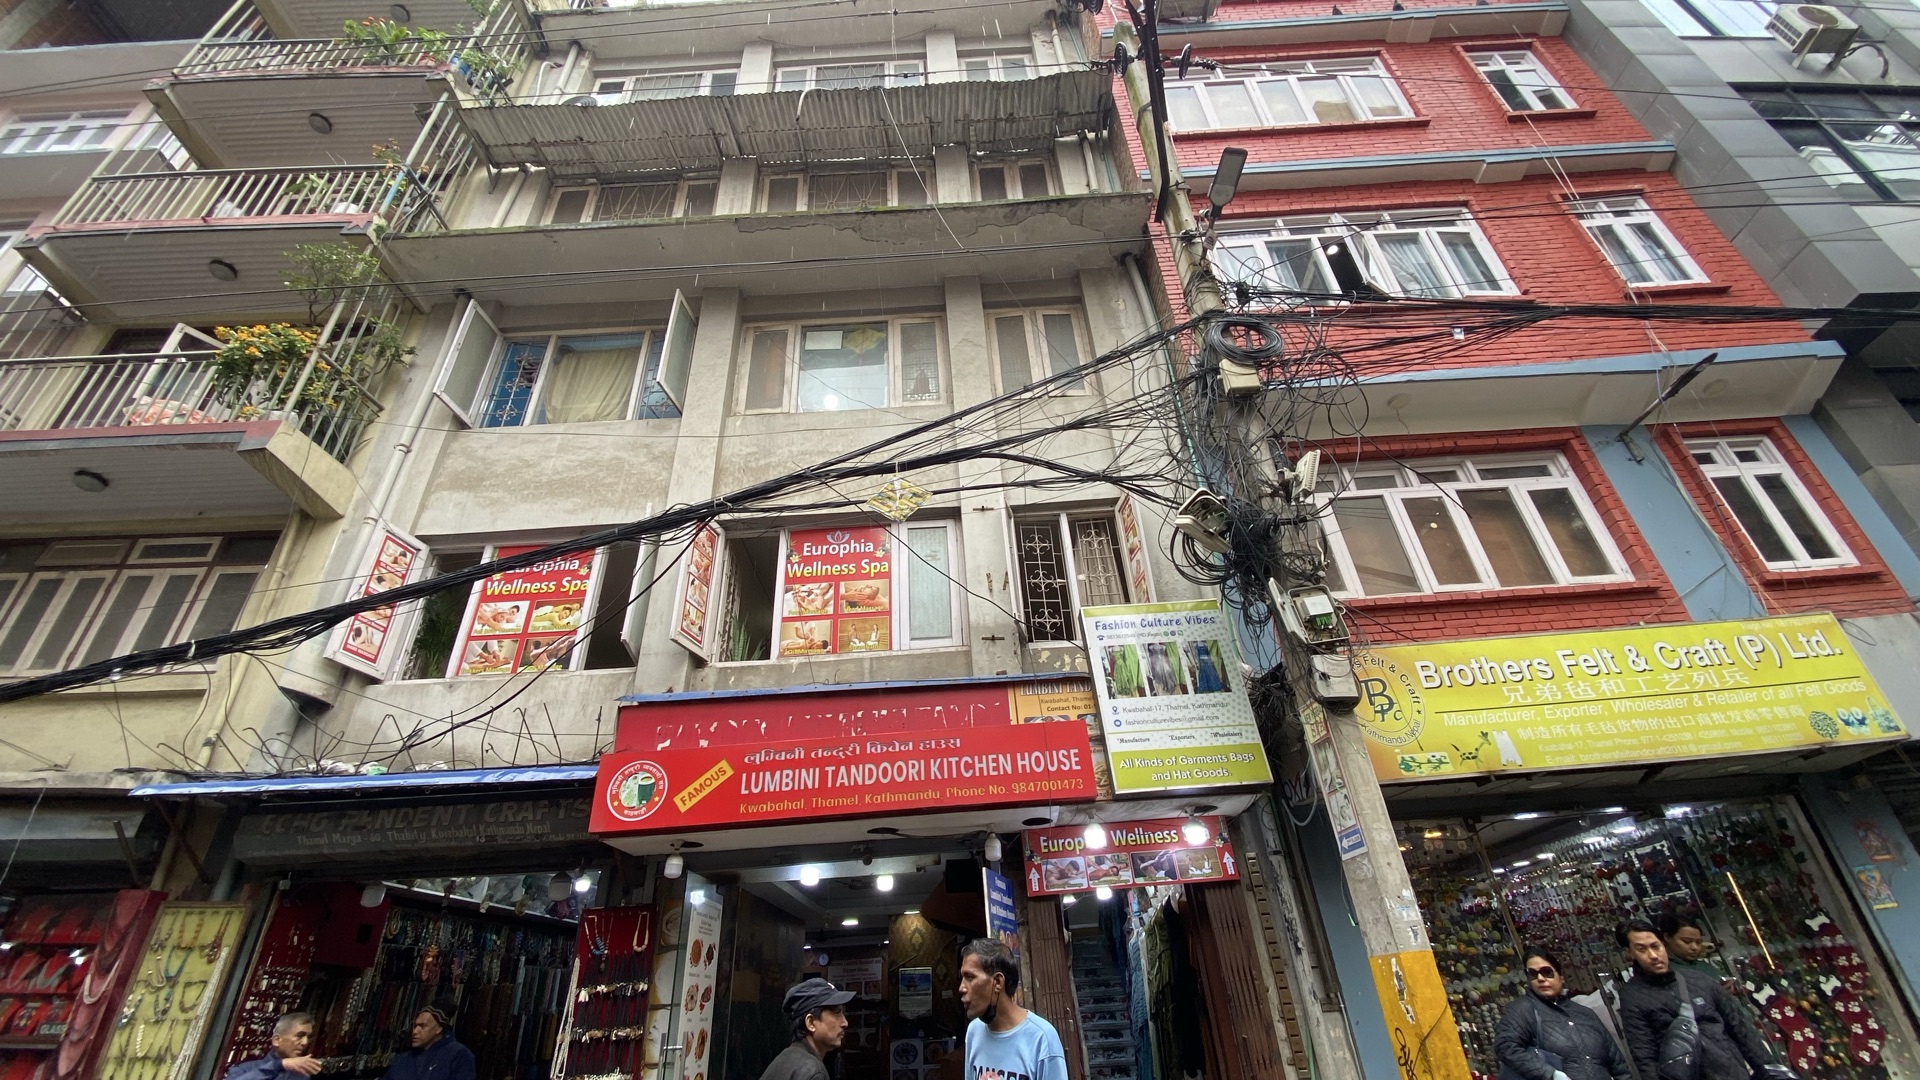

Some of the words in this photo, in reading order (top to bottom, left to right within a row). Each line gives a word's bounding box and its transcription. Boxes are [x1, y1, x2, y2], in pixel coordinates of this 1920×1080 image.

[803, 539, 874, 557] Europhia
[505, 557, 579, 575] rophia
[787, 561, 856, 578] Wellness
[861, 559, 889, 577] Spa
[486, 579, 557, 596] Wellness
[560, 577, 588, 595] Spa
[1095, 620, 1136, 631] Fashion
[1140, 617, 1181, 628] Culture
[1184, 615, 1216, 625] Vibes
[1414, 656, 1554, 689] Brothers
[1555, 648, 1622, 677] Felt
[1624, 645, 1652, 672] &
[1654, 637, 1734, 670] Craft
[1734, 633, 1782, 669] (P)
[1779, 629, 1842, 660] Ltd.
[1021, 681, 1062, 696] LUMBINI
[1362, 654, 1384, 667] Felt
[1389, 664, 1396, 673] &
[1400, 674, 1420, 704] Craft
[1444, 709, 1541, 727] Manufacturer,
[1544, 704, 1608, 720] Exporter,
[1611, 693, 1688, 714] Wholesaler
[1693, 693, 1704, 706] &
[1706, 687, 1758, 706] Retailer
[1762, 686, 1775, 701] of
[1778, 684, 1794, 699] all
[1797, 682, 1821, 697] Felt
[1824, 679, 1866, 694] Goods
[1362, 722, 1406, 744] Kathmandu
[1405, 719, 1420, 740] Nepal
[744, 747, 805, 765] लुम्बिनी
[1120, 758, 1133, 769] All
[1135, 757, 1163, 768] Kinds
[1165, 756, 1177, 766] of
[1179, 754, 1228, 764] Garments
[1230, 751, 1255, 763] Bags
[740, 767, 820, 795] LUMBINI
[825, 759, 925, 788] TANDOORI
[930, 753, 1012, 780] KITCHEN
[1016, 748, 1081, 774] HOUSE
[1151, 771, 1171, 781] and
[1173, 769, 1191, 780] Hat
[1193, 767, 1232, 778] Goods.
[679, 766, 727, 806] FAMOUS
[740, 799, 807, 813] Kwabahal,
[946, 784, 985, 798] Phone
[989, 784, 1009, 795] No.
[1011, 778, 1084, 793] 9847001473
[332, 833, 362, 846] Marga
[1040, 832, 1108, 854] Europ
[1110, 827, 1179, 847] Wellness
